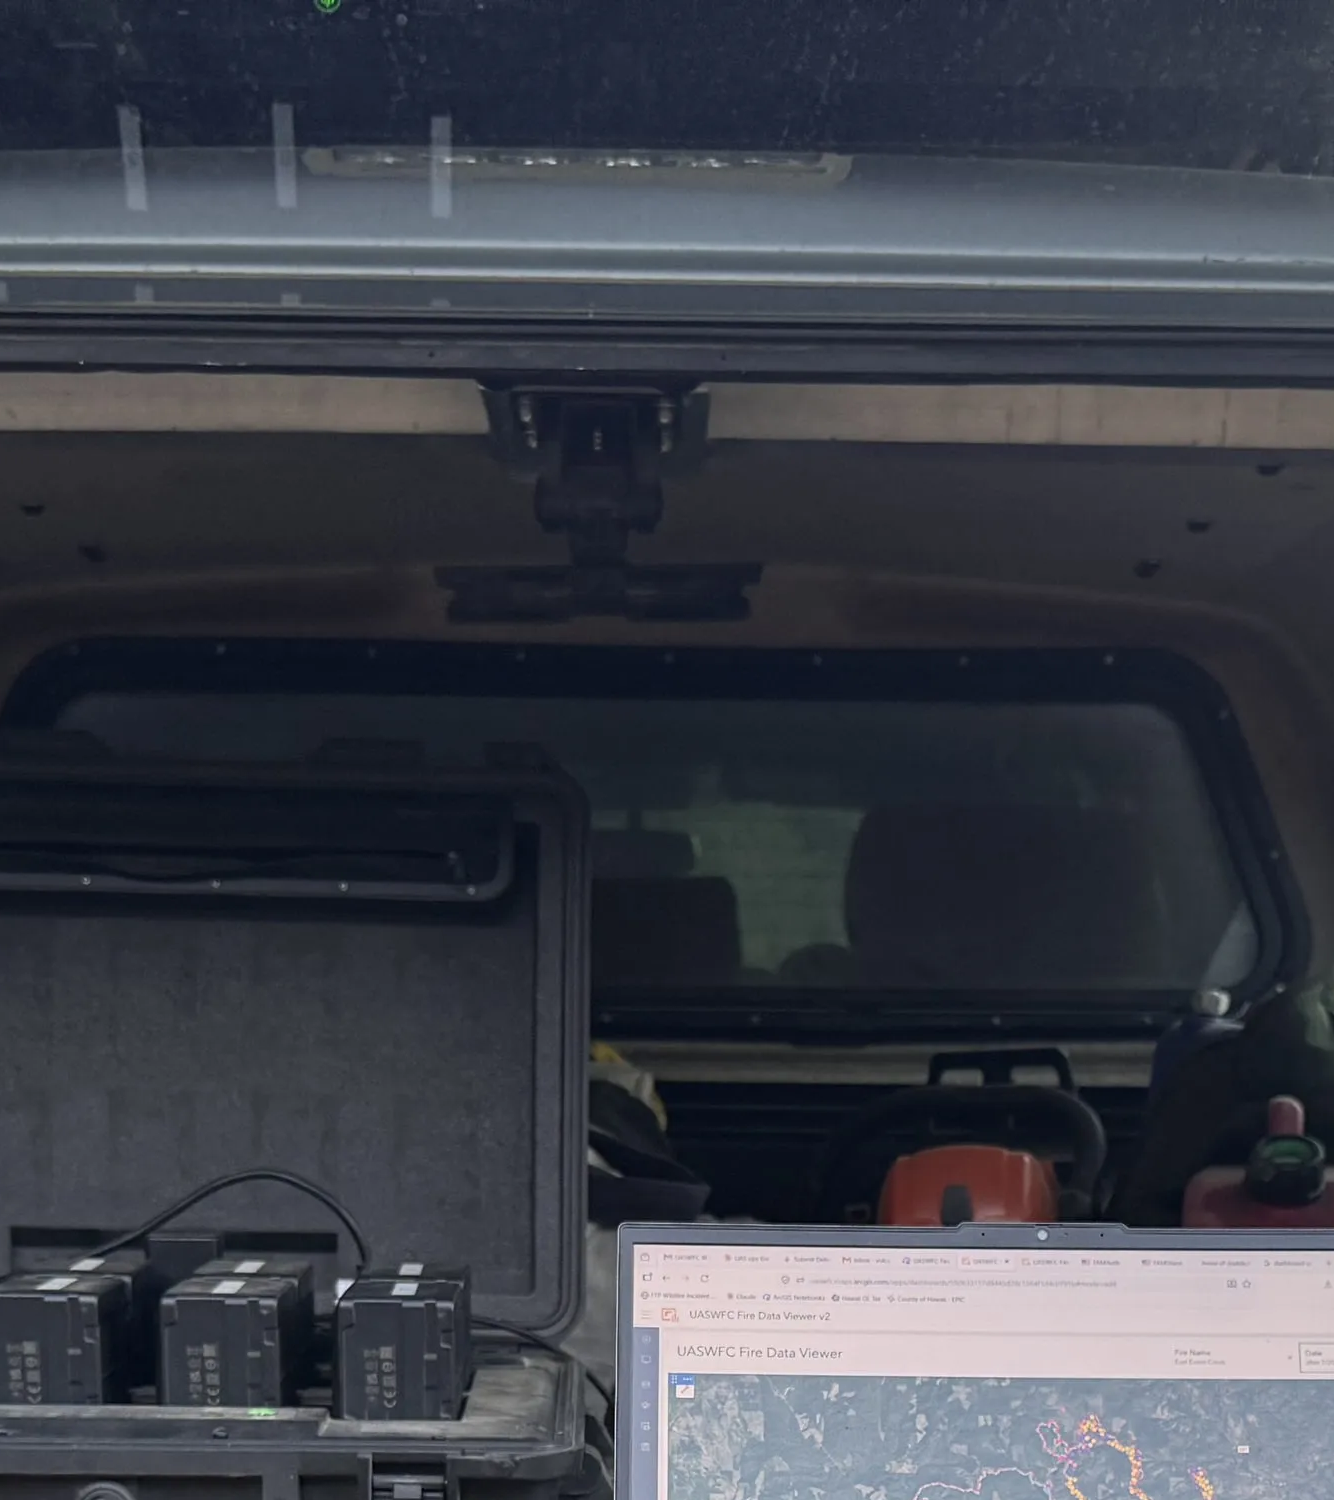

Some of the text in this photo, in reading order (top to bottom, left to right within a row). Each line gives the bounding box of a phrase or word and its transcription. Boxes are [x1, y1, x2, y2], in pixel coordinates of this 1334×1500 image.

[689, 1311, 830, 1322] UASWFC Fire Data Viewer v2
[677, 1345, 842, 1359] UASWFC Fire Data Viewer
